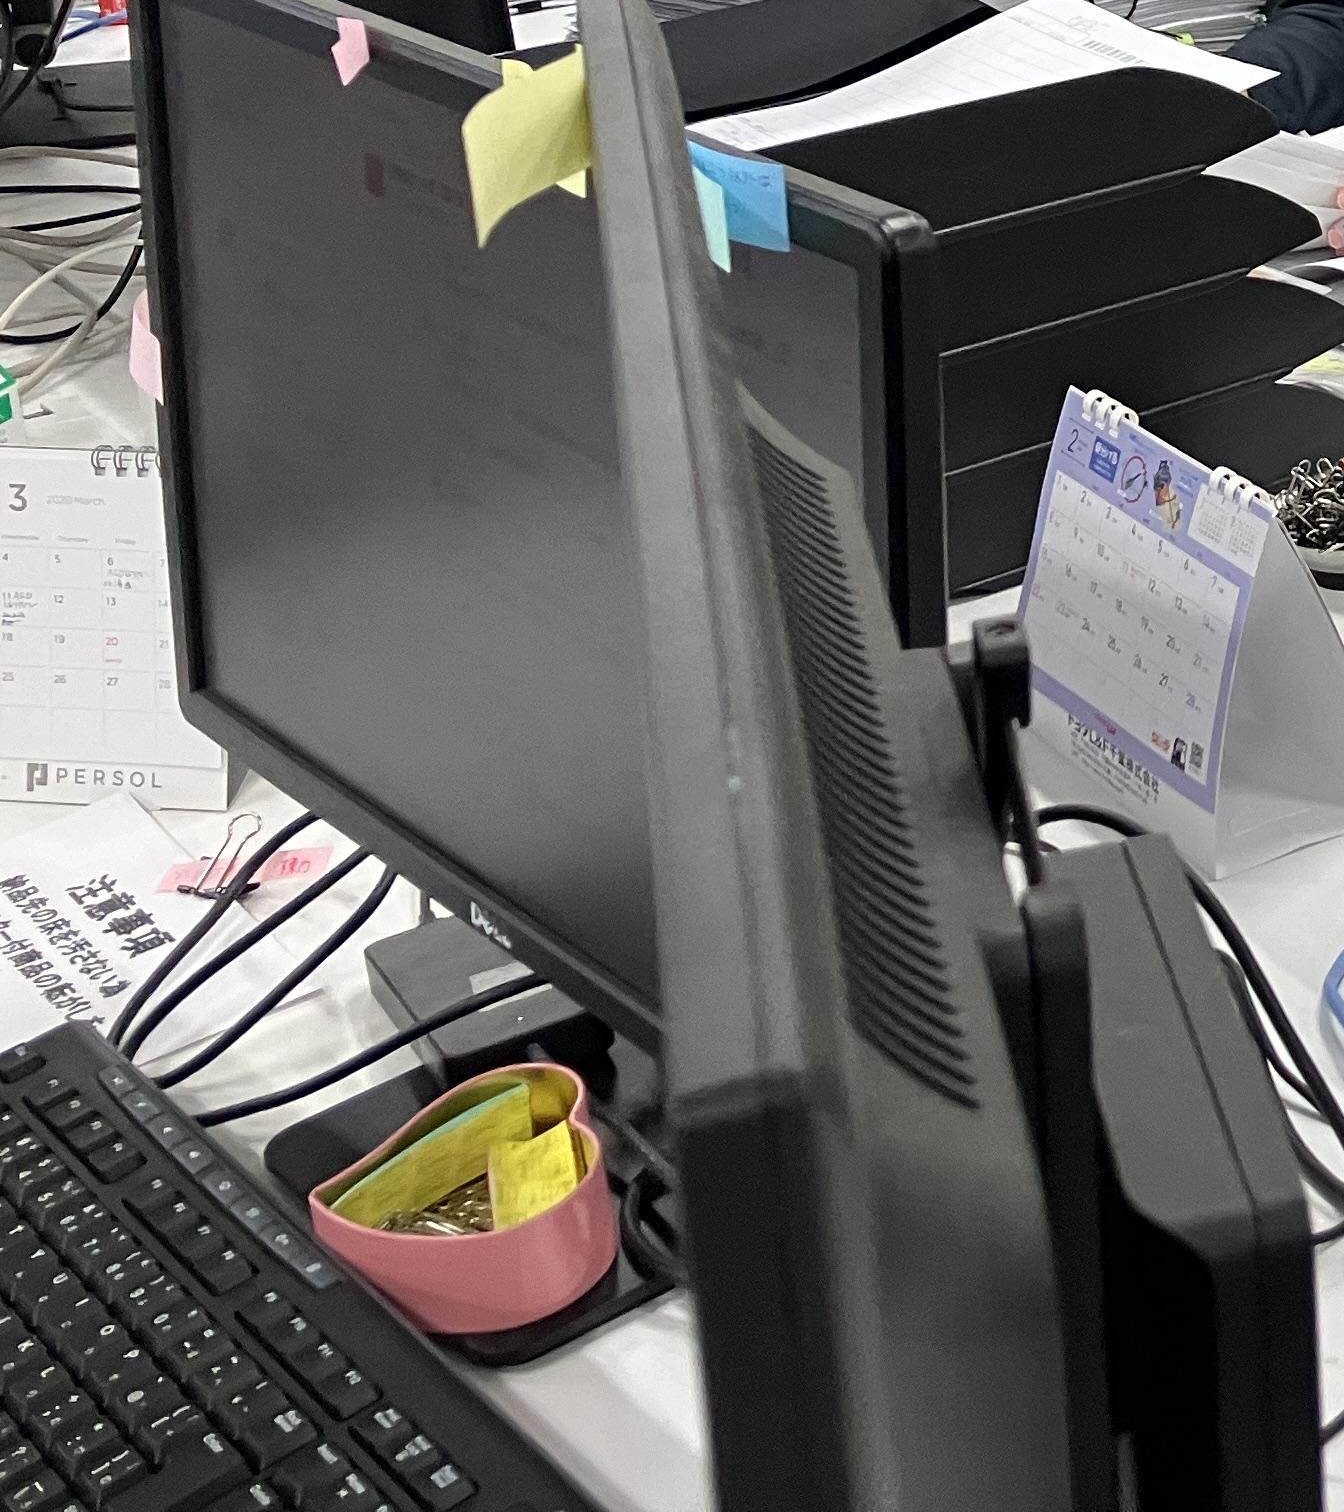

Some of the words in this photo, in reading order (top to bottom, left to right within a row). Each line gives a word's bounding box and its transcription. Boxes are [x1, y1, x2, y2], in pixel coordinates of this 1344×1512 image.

[8, 483, 28, 512] 3
[106, 597, 116, 607] 13
[56, 767, 163, 788] PERSOL
[65, 873, 177, 959] 注意事項
